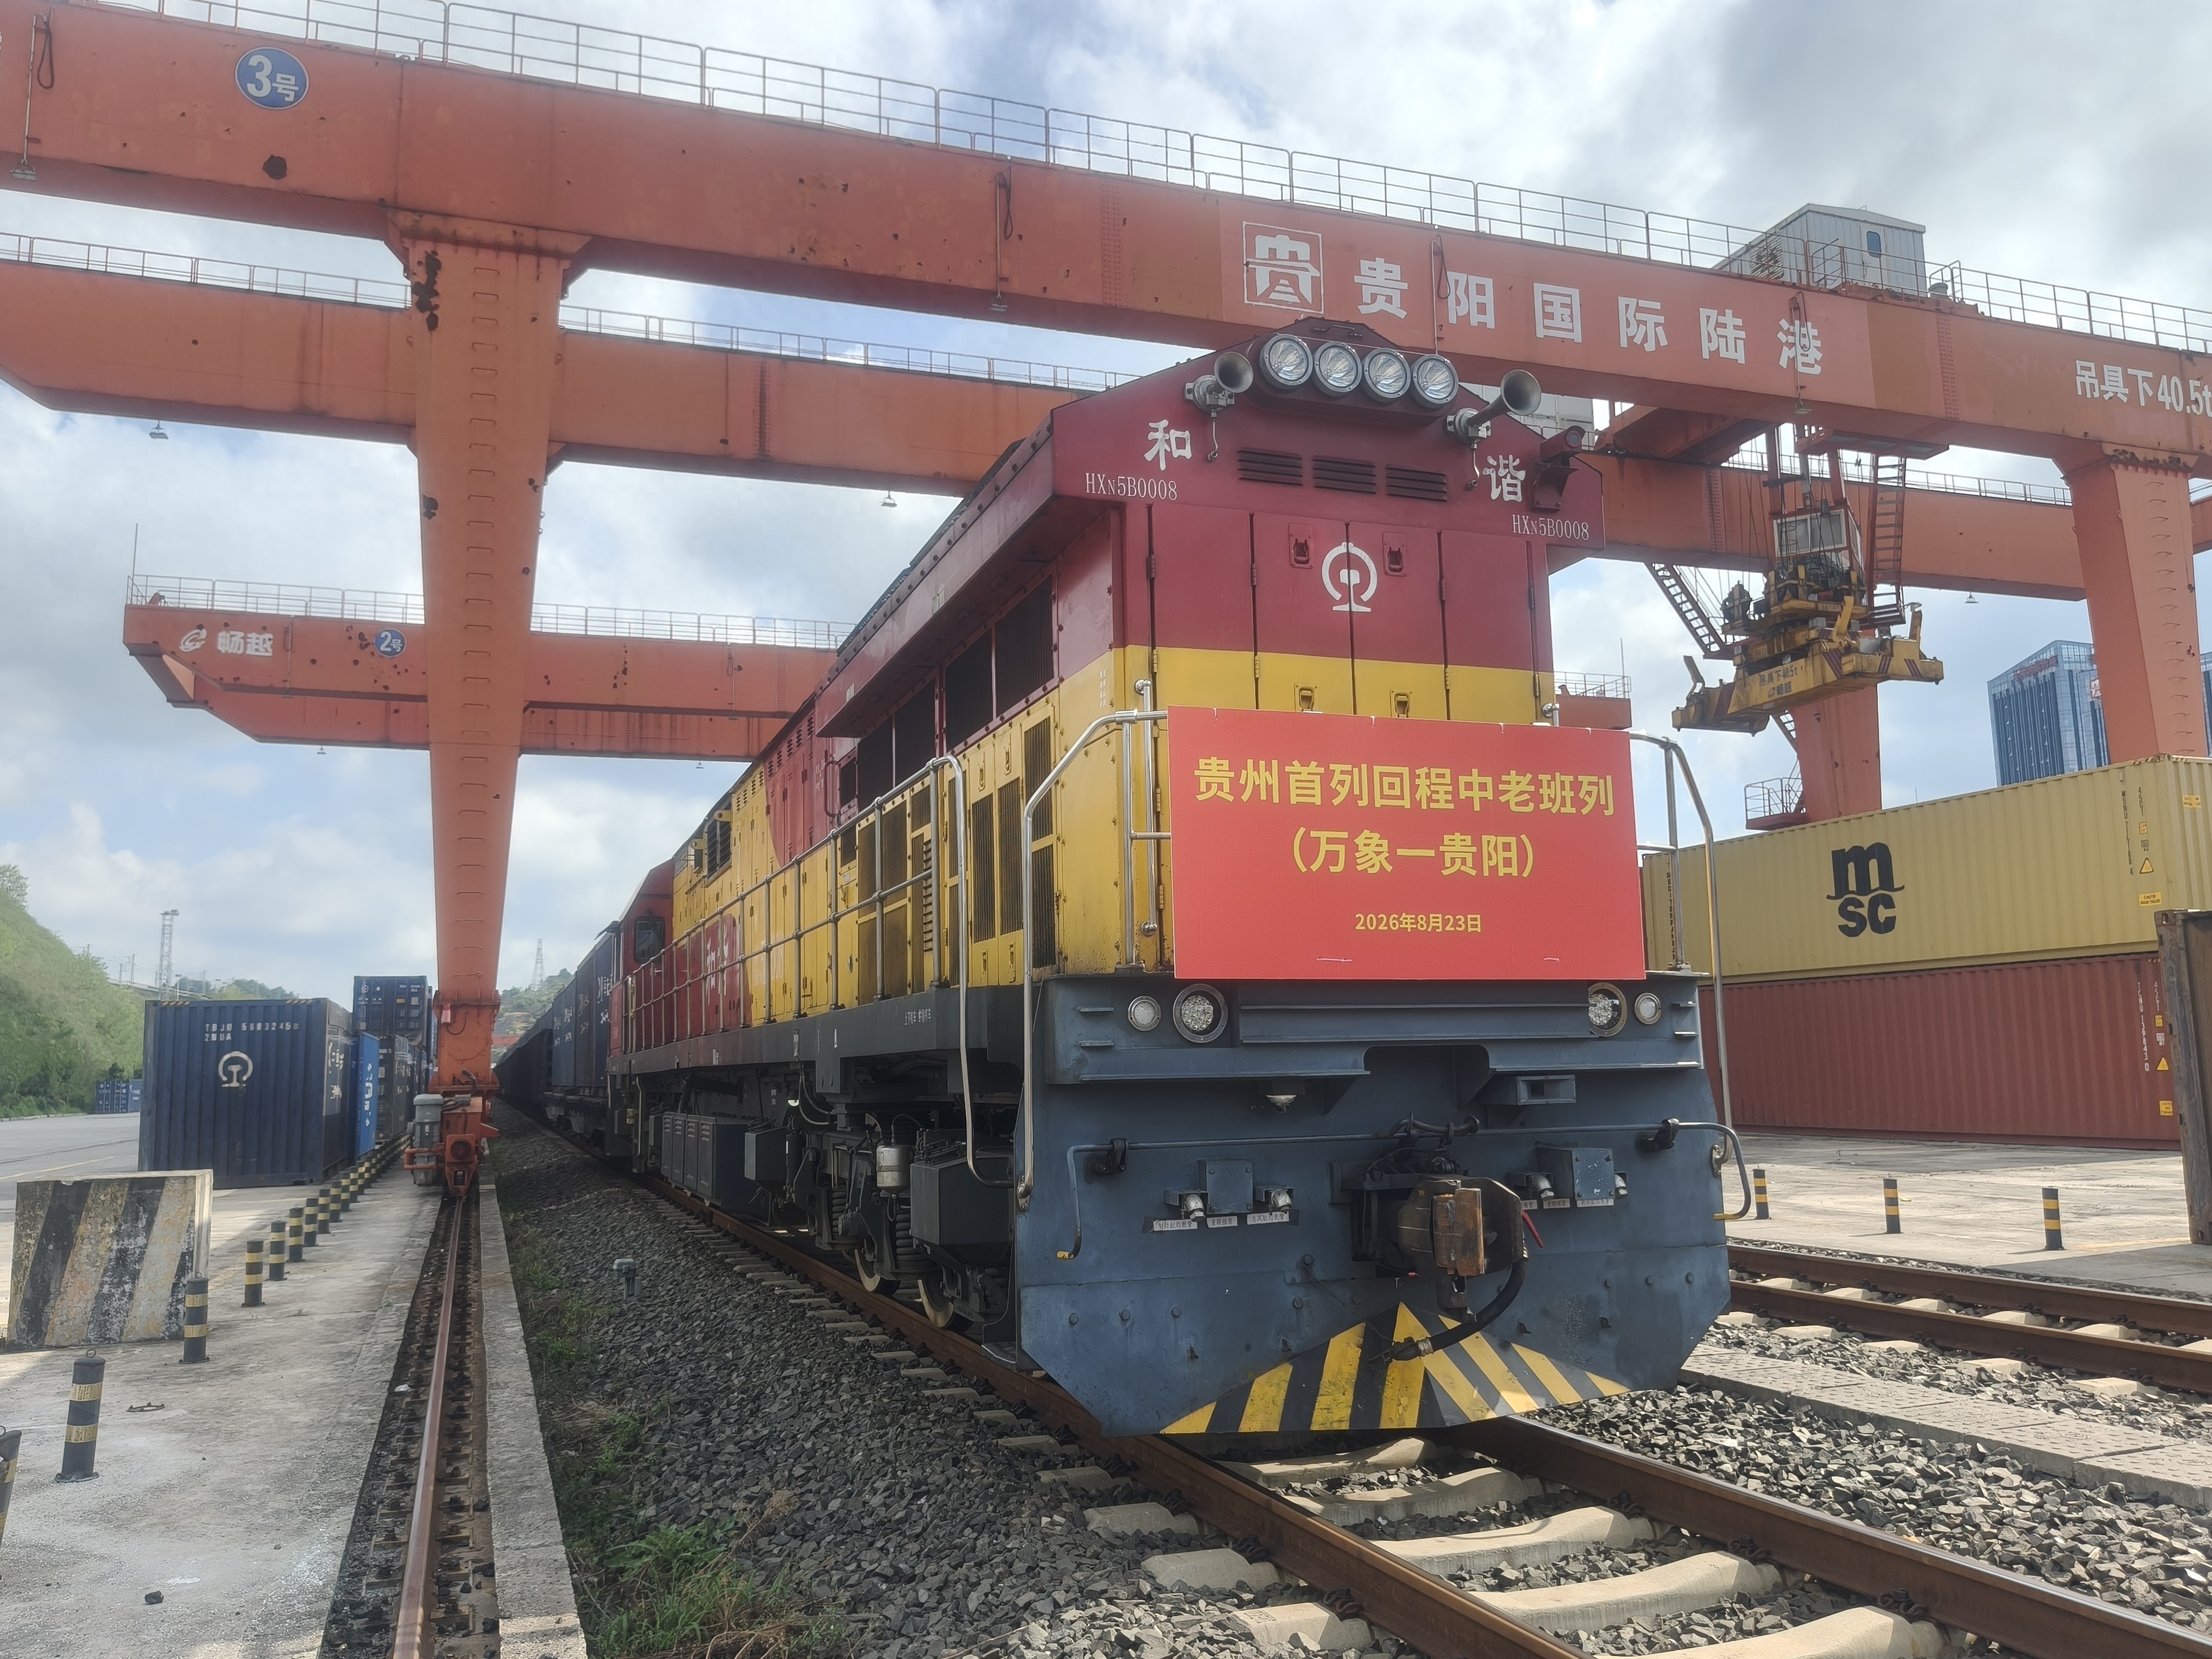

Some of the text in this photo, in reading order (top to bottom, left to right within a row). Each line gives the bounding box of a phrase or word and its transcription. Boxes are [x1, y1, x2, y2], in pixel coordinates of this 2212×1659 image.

[247, 54, 299, 102] 3号
[1354, 256, 1823, 376] 贵阳国际陆港
[1144, 419, 1526, 502] 和 谐
[1085, 472, 1178, 501] HXN5B0008
[1511, 514, 1589, 541] HXN5B0008
[379, 631, 403, 652] 2号
[1194, 757, 1615, 817] 贵州首列回程中老班列
[1355, 913, 1481, 933] 2026年8月23日
